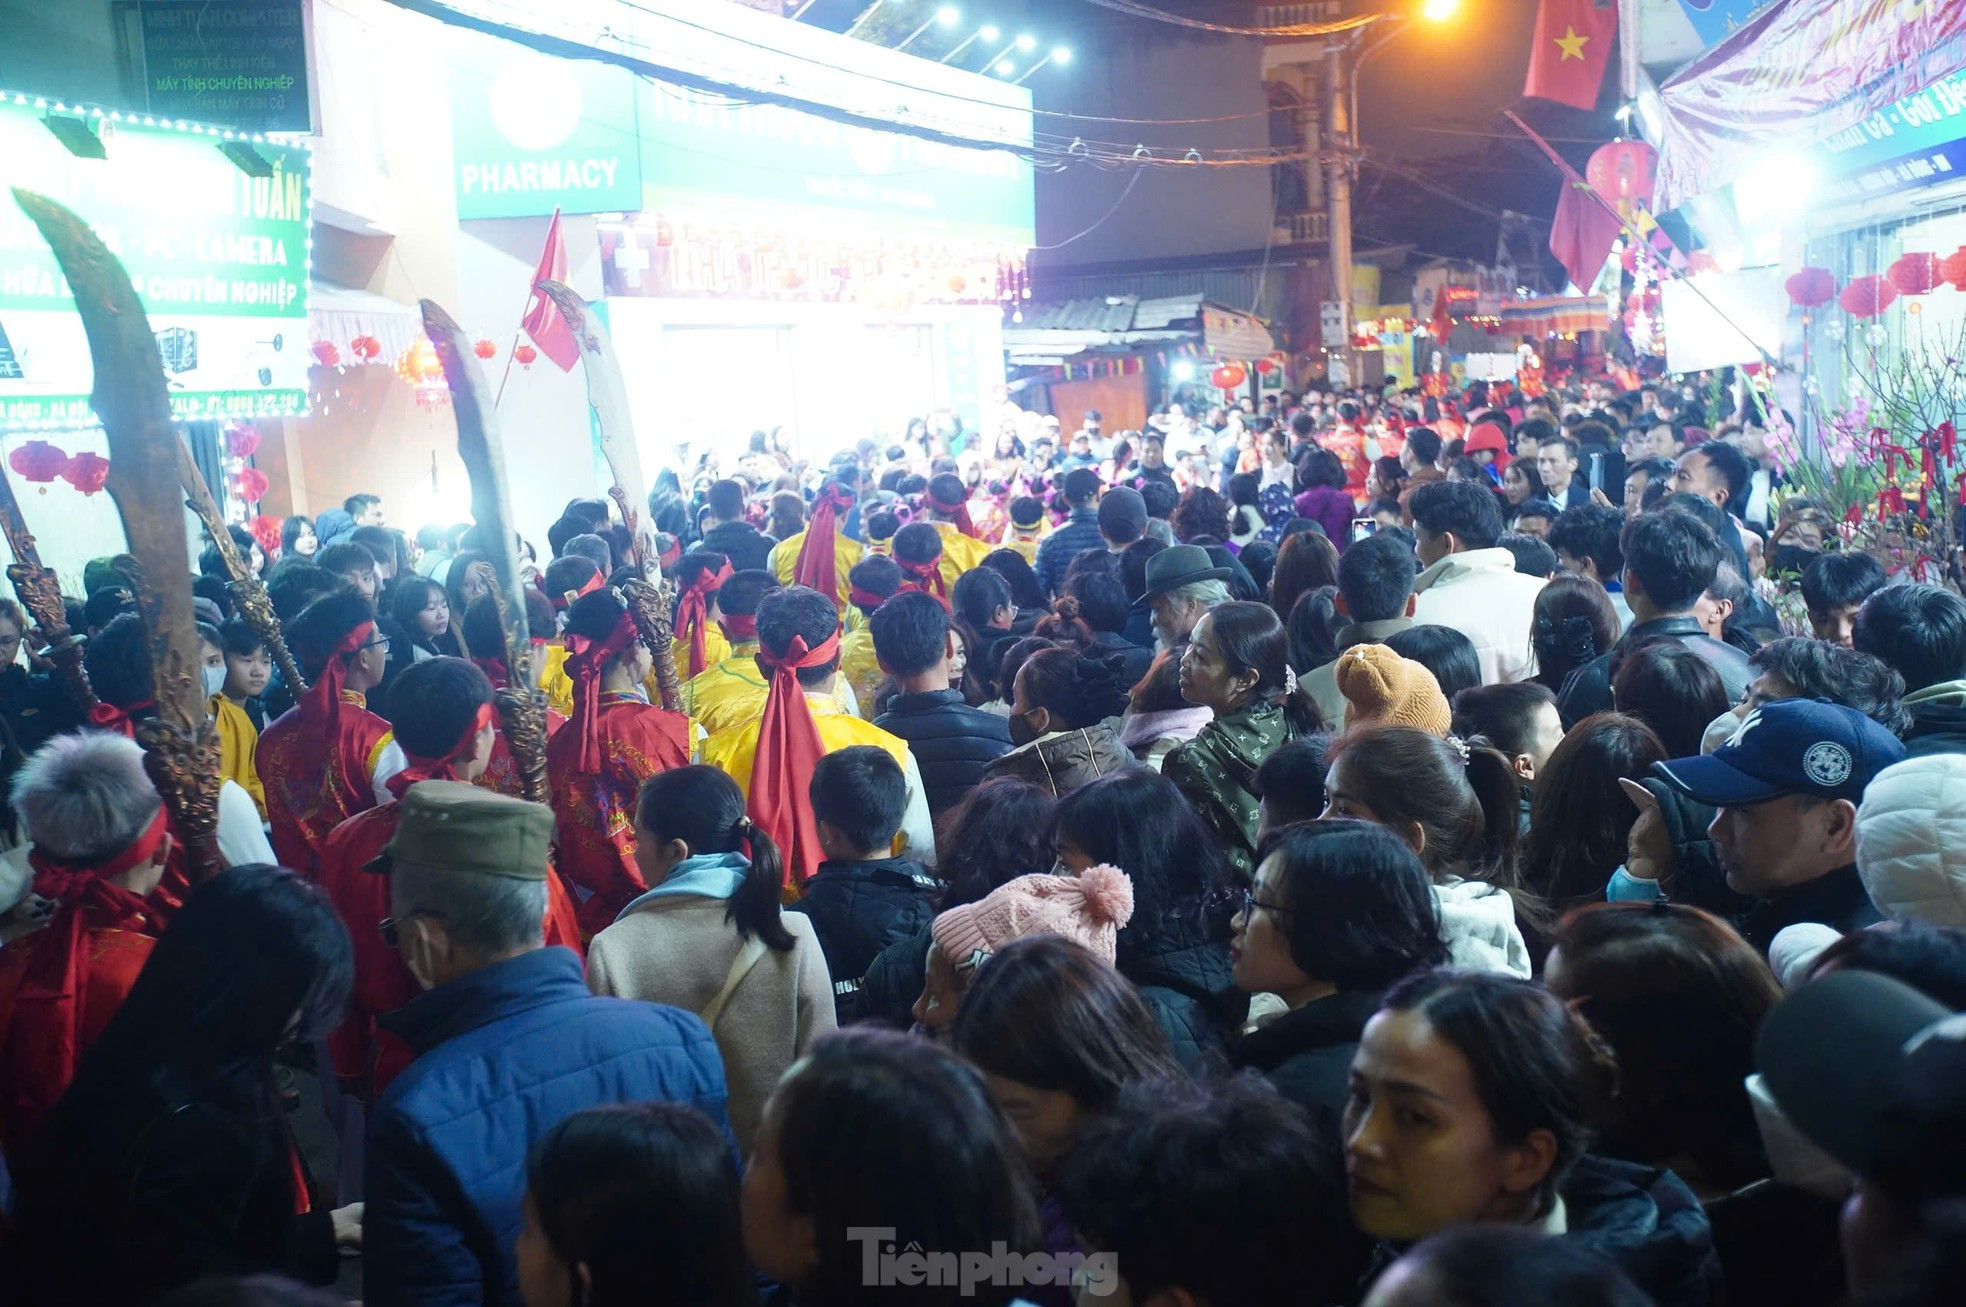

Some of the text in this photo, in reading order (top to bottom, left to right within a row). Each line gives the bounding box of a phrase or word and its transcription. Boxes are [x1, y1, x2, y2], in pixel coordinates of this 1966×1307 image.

[157, 74, 295, 92] MÁY TÍNH CHUYÊN NGHIỆP
[461, 158, 619, 195] PHARMACY
[195, 232, 288, 266] CAMERA
[147, 272, 229, 304] CHUYÊN
[231, 276, 298, 312] NGHIỆP
